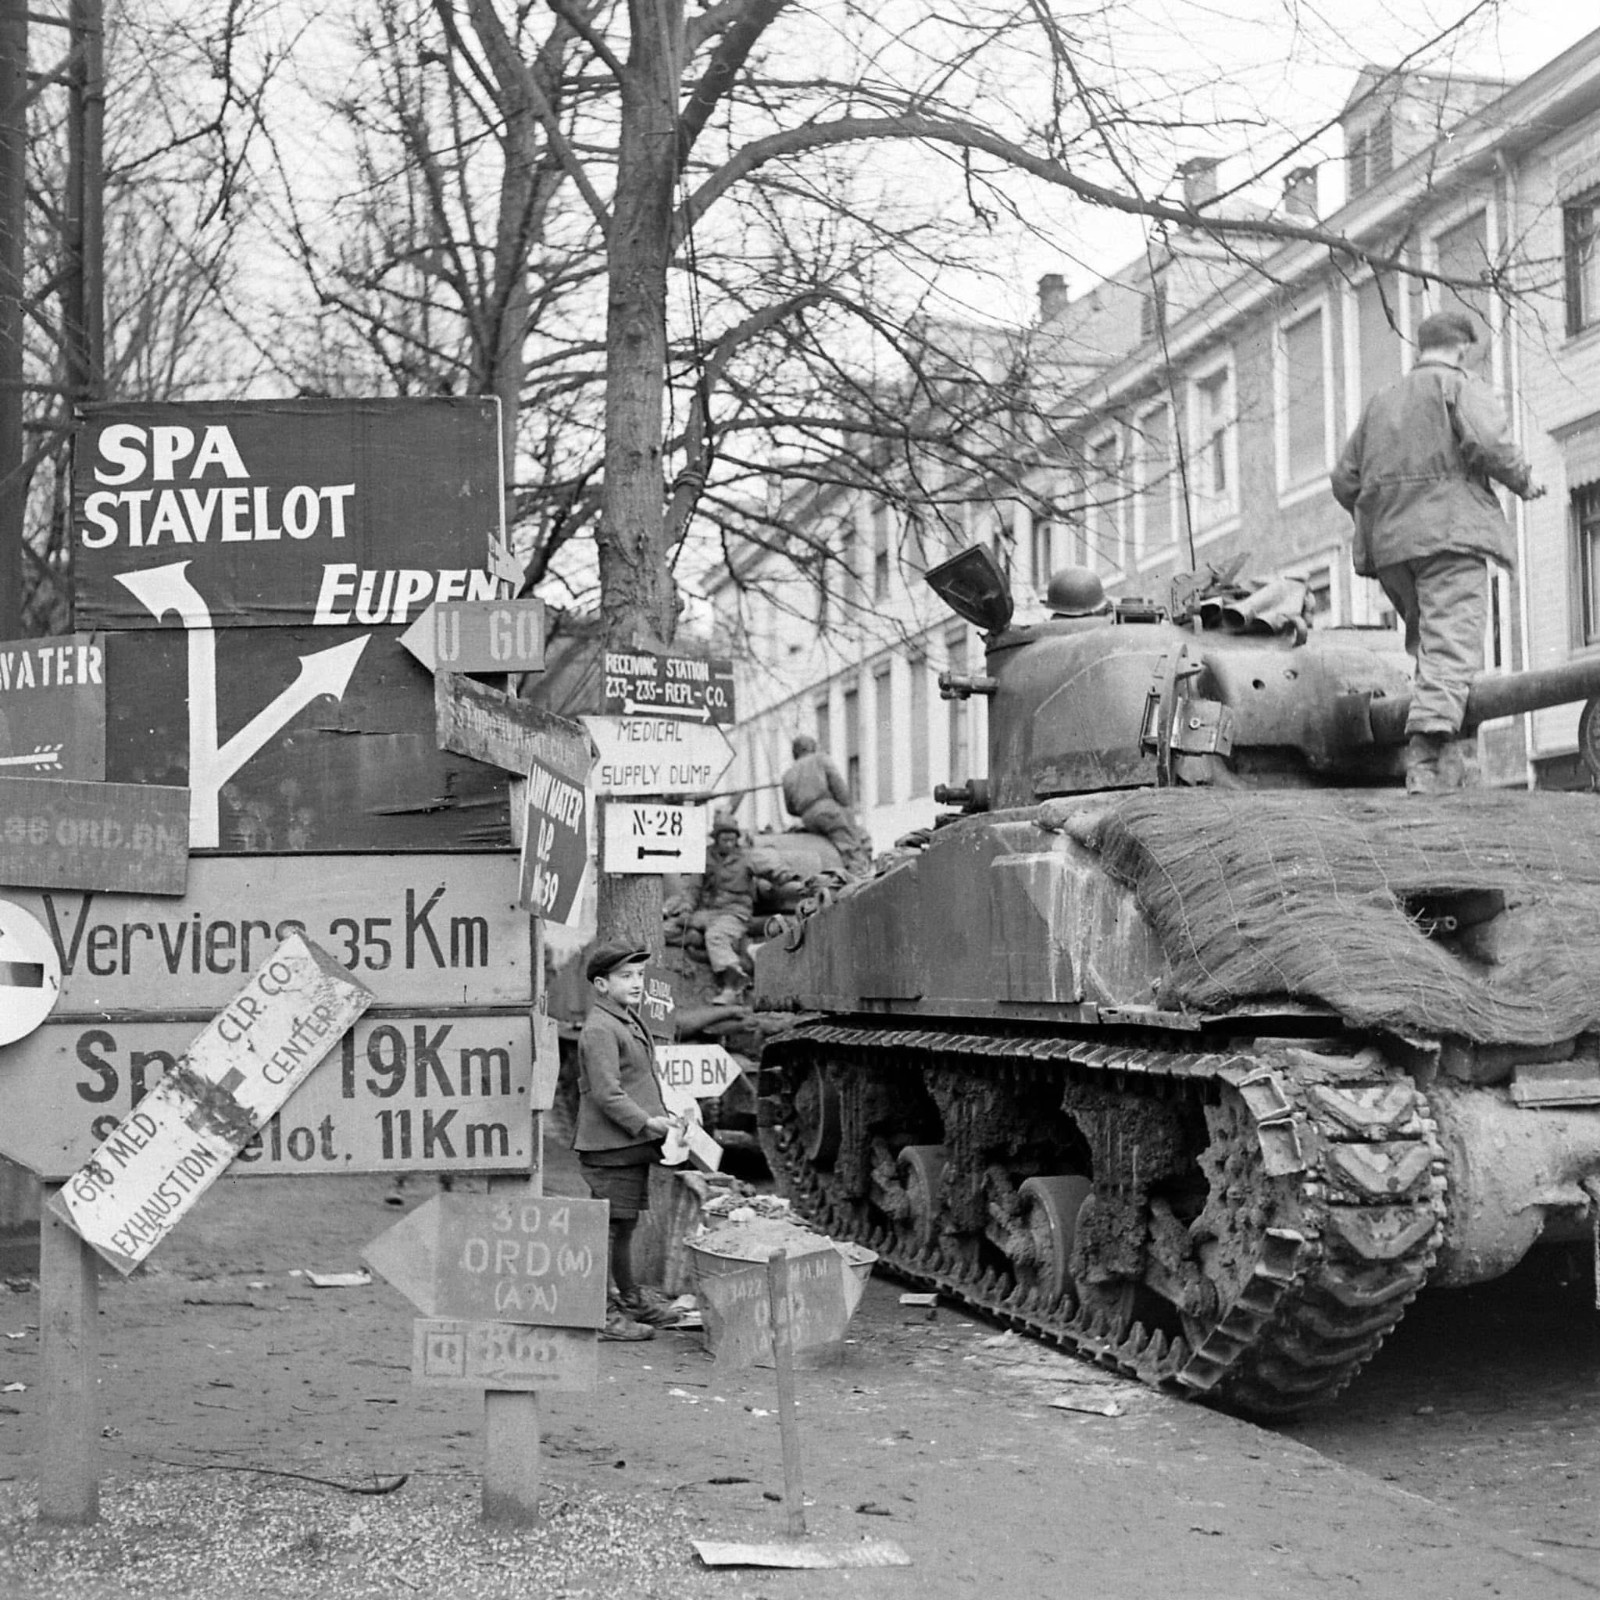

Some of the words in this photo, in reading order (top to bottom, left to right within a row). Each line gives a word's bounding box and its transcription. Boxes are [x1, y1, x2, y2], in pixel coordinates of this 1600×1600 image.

[93, 423, 251, 486] SPA
[81, 483, 355, 549] STAVELOT
[313, 563, 500, 626] EUPEN
[666, 658, 710, 682] STATION
[618, 721, 683, 742] MEDICAL
[601, 764, 660, 786] SUPPLY
[670, 764, 711, 787] DUMP
[546, 778, 583, 836] WATER
[701, 1058, 728, 1085] BN
[110, 1142, 220, 1258] EXHAUSTION
[261, 1003, 338, 1086] CENTER
[492, 1204, 571, 1236] 304
